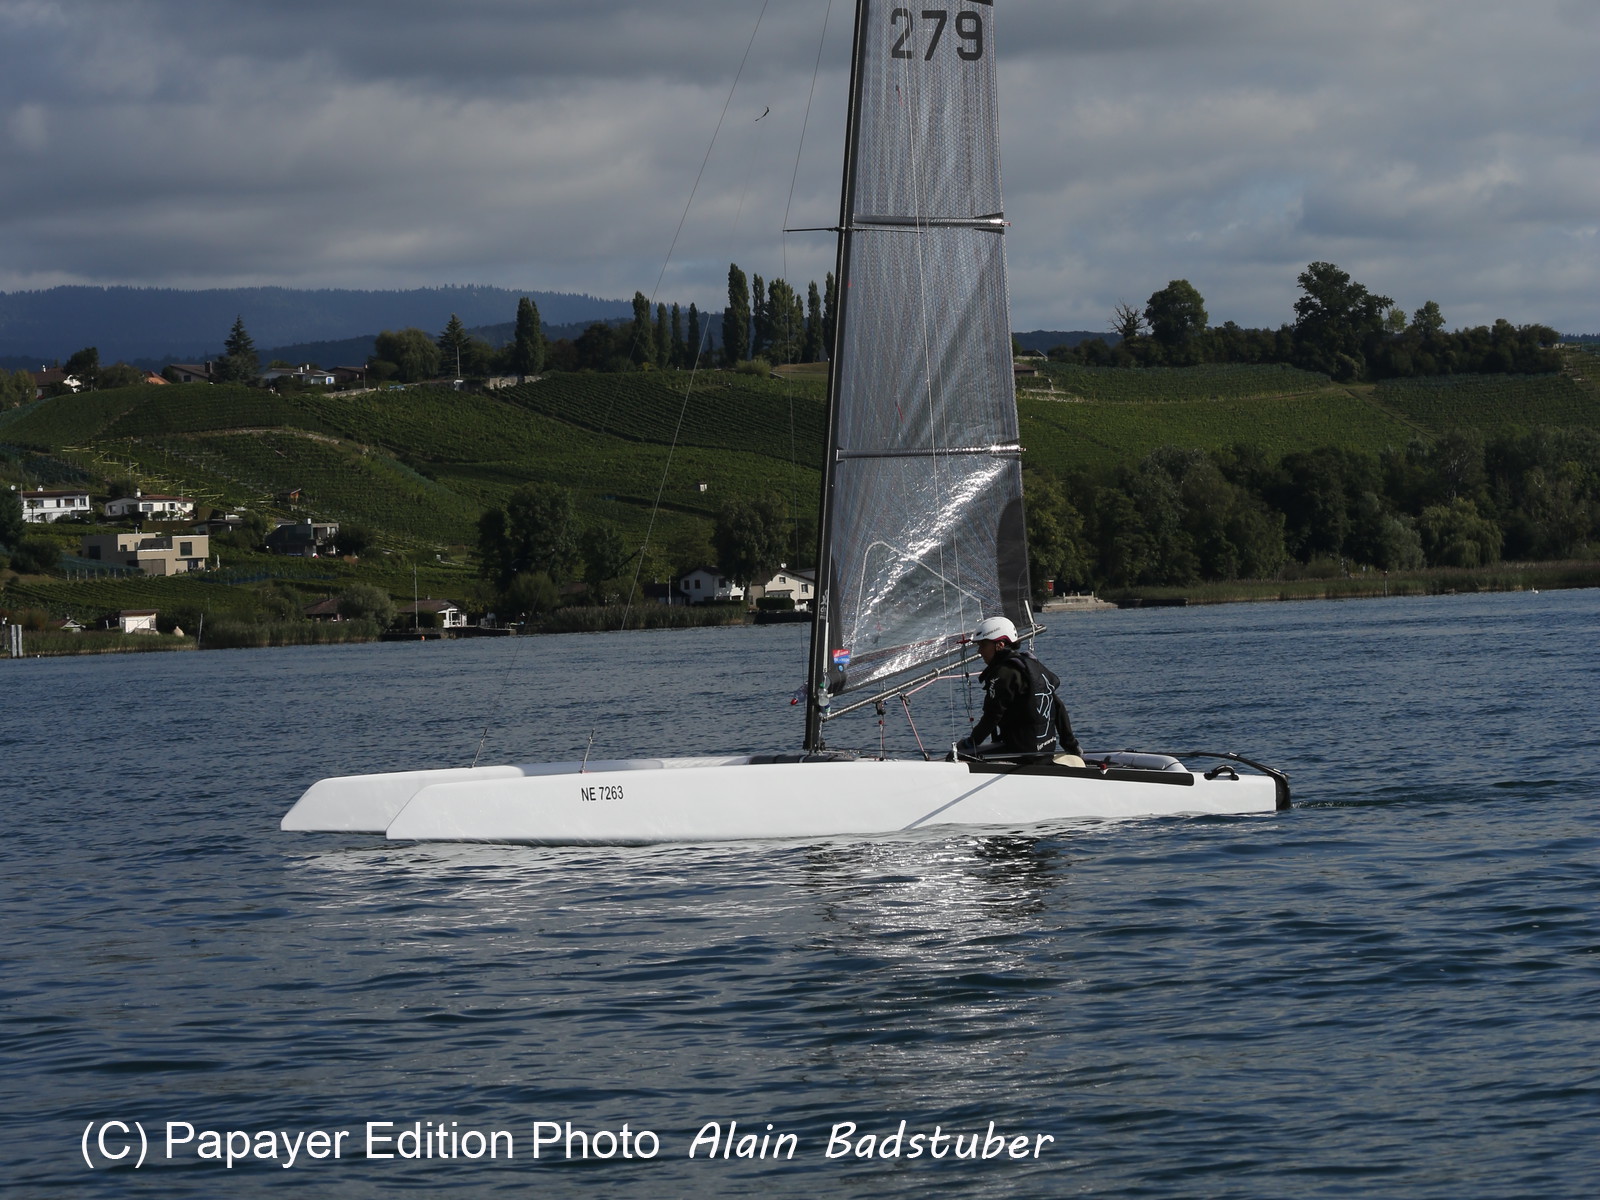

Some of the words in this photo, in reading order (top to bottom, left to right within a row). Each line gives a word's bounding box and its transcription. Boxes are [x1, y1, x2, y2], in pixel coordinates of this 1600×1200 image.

[890, 7, 983, 61] 279
[581, 786, 597, 802] NE
[598, 785, 624, 801] 7263
